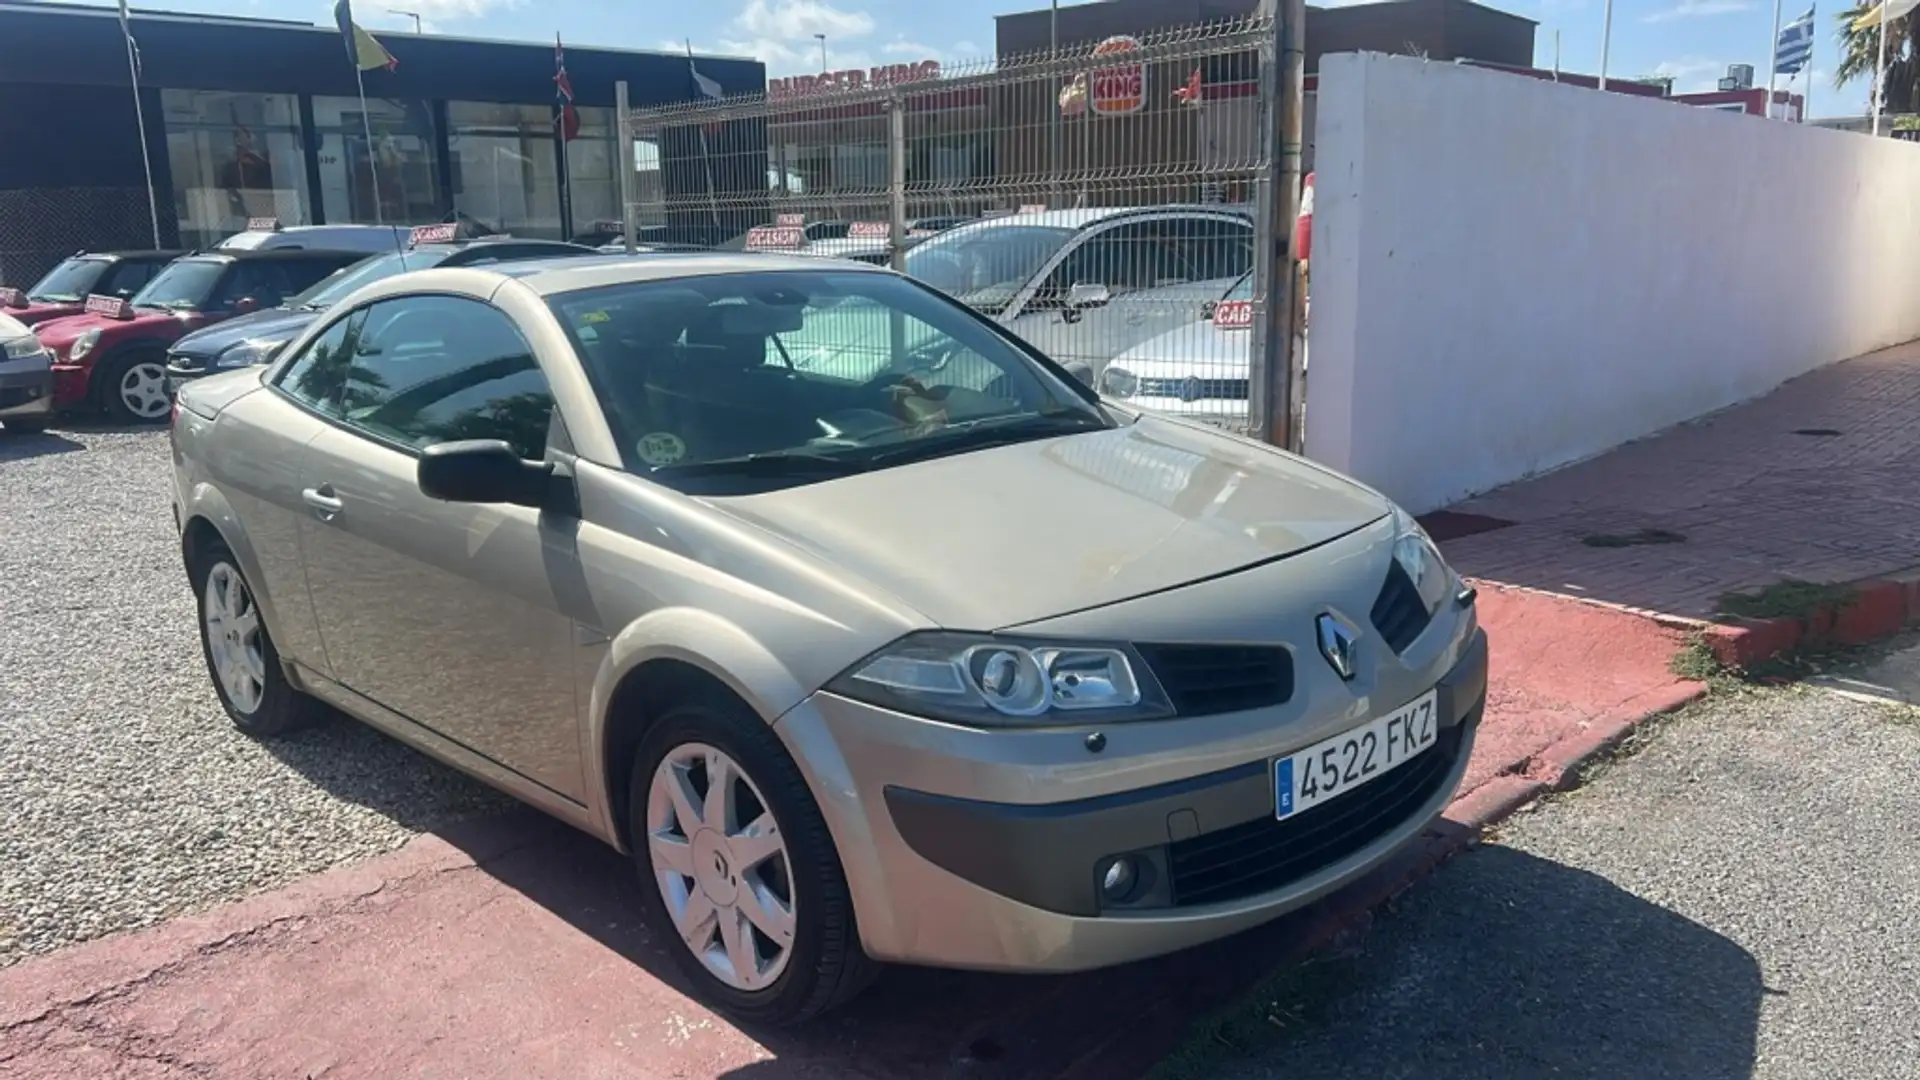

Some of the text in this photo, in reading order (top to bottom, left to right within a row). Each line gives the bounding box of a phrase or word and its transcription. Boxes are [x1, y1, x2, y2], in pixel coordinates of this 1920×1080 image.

[871, 60, 940, 88] KING
[1097, 75, 1142, 100] KING
[1217, 303, 1252, 324] CAB
[1301, 699, 1432, 798] 4522 FKZ
